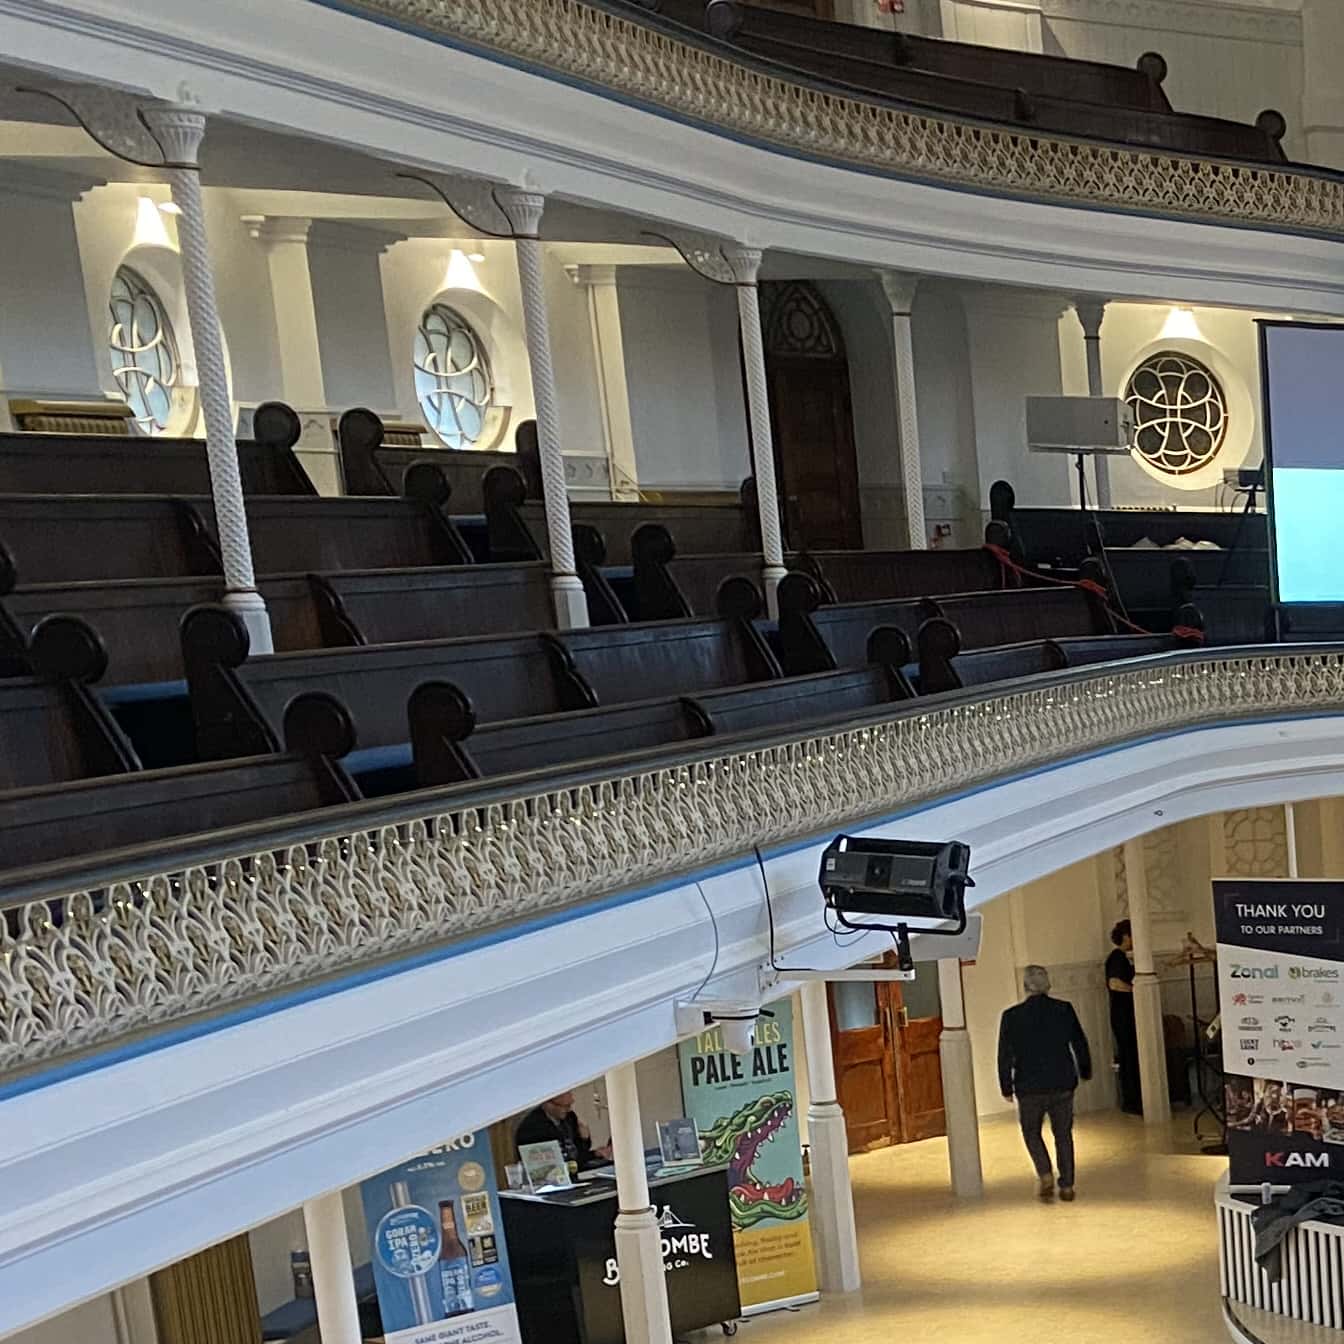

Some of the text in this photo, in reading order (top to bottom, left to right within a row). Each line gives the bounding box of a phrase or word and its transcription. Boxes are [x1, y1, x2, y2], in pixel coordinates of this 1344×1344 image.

[1235, 903, 1325, 919] THANK YOU
[1240, 925, 1323, 936] TO OUR PARTNERS
[1230, 963, 1279, 979] Zonal
[1302, 966, 1339, 978] brakes
[695, 1030, 726, 1053] TAL
[691, 1043, 789, 1086] PALE ALE
[1264, 1152, 1329, 1168] KAM
[438, 1327, 464, 1340] GIANT
